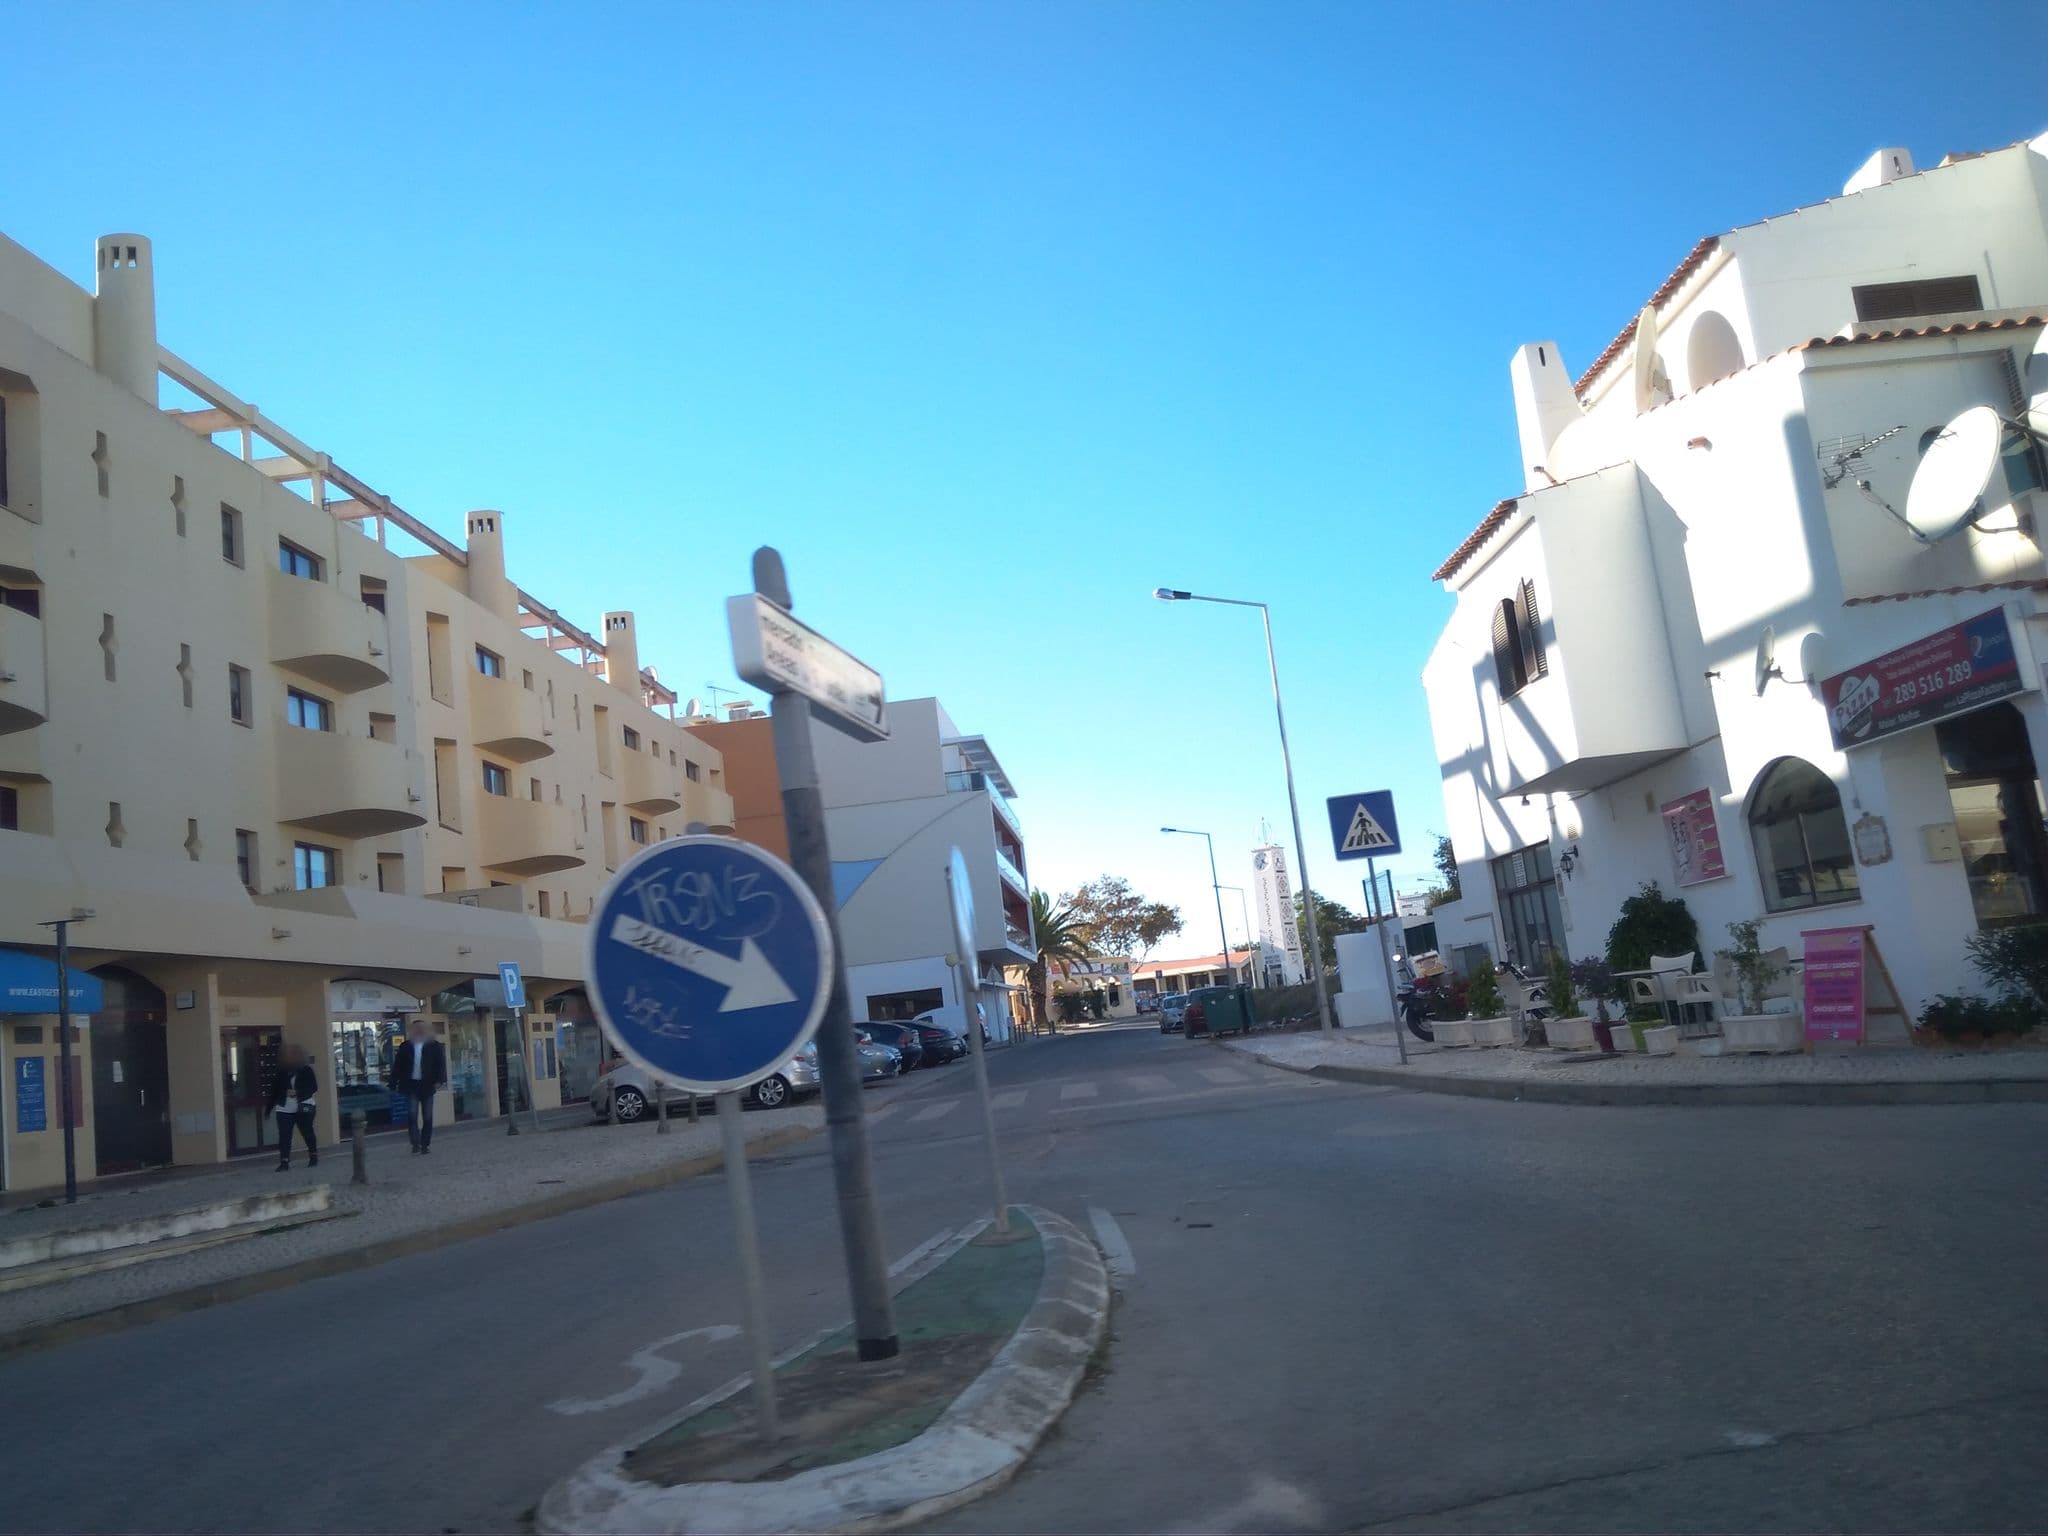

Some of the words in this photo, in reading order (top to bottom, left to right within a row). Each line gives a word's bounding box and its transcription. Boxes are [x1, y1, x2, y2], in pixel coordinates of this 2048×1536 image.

[1894, 682, 1917, 704] 289
[1921, 671, 1944, 695] 516
[1948, 660, 1973, 685] 289
[504, 968, 518, 1002] P
